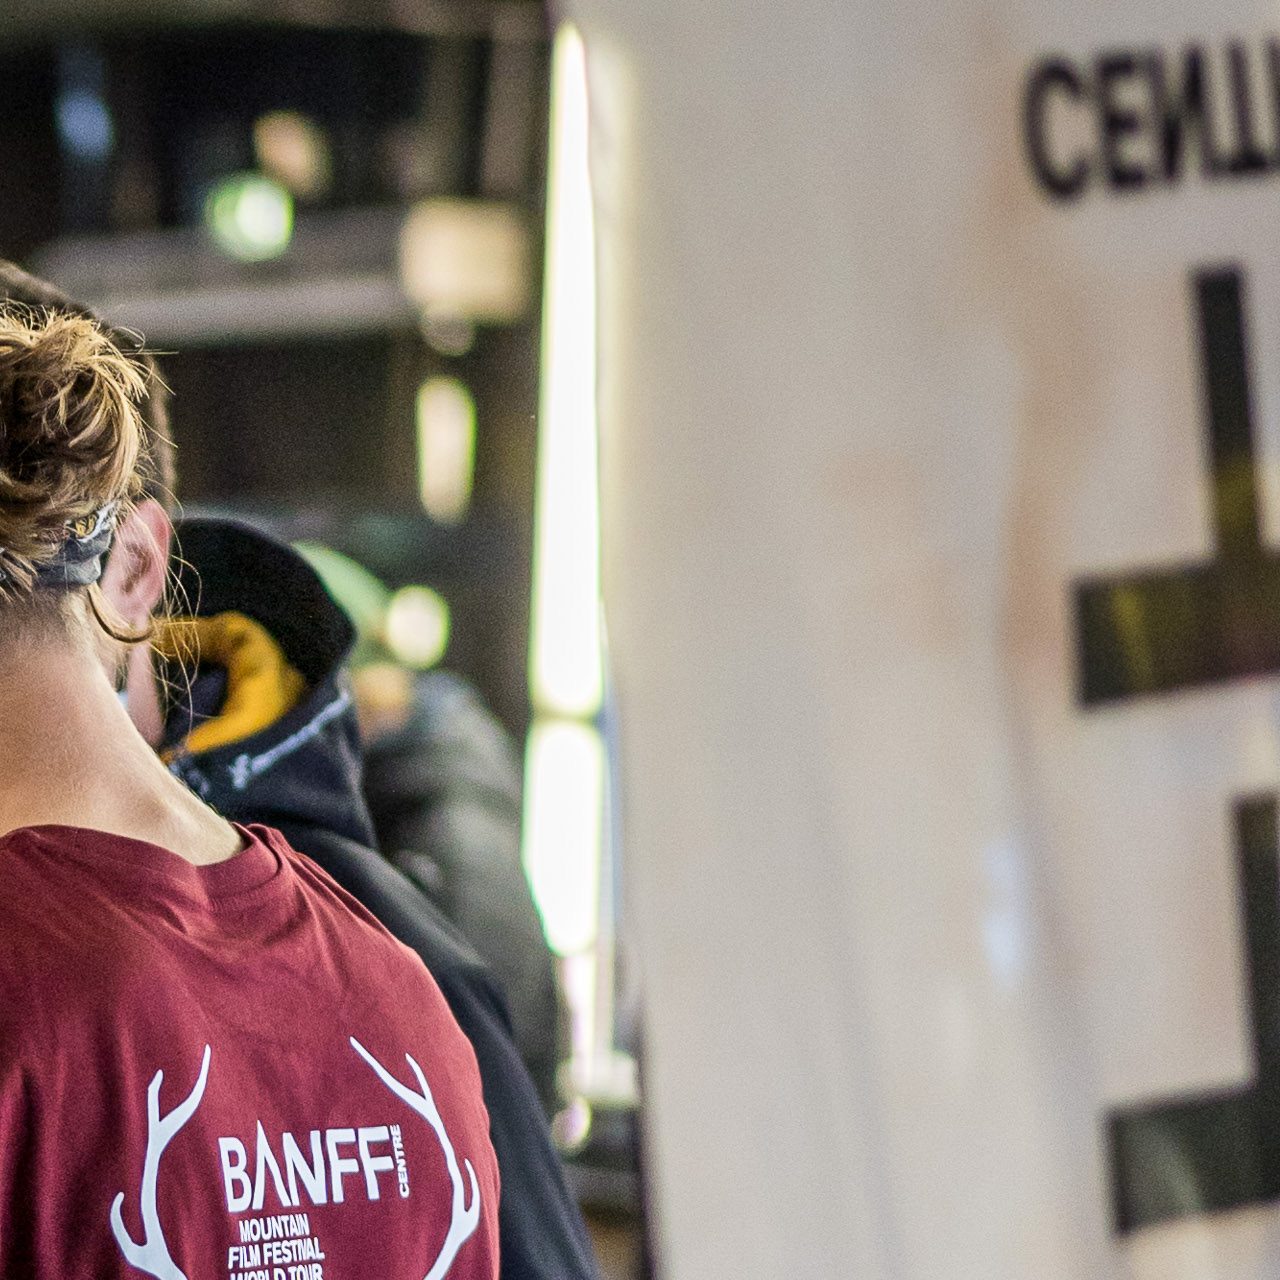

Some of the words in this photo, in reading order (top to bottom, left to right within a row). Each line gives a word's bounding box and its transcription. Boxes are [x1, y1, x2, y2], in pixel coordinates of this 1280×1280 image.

[218, 1120, 395, 1213] BANFF
[389, 1124, 410, 1199] CENTRE
[228, 1245, 261, 1270] FILM
[263, 1236, 326, 1266] FESTIVAL
[238, 1213, 310, 1243] MOUNTAIN
